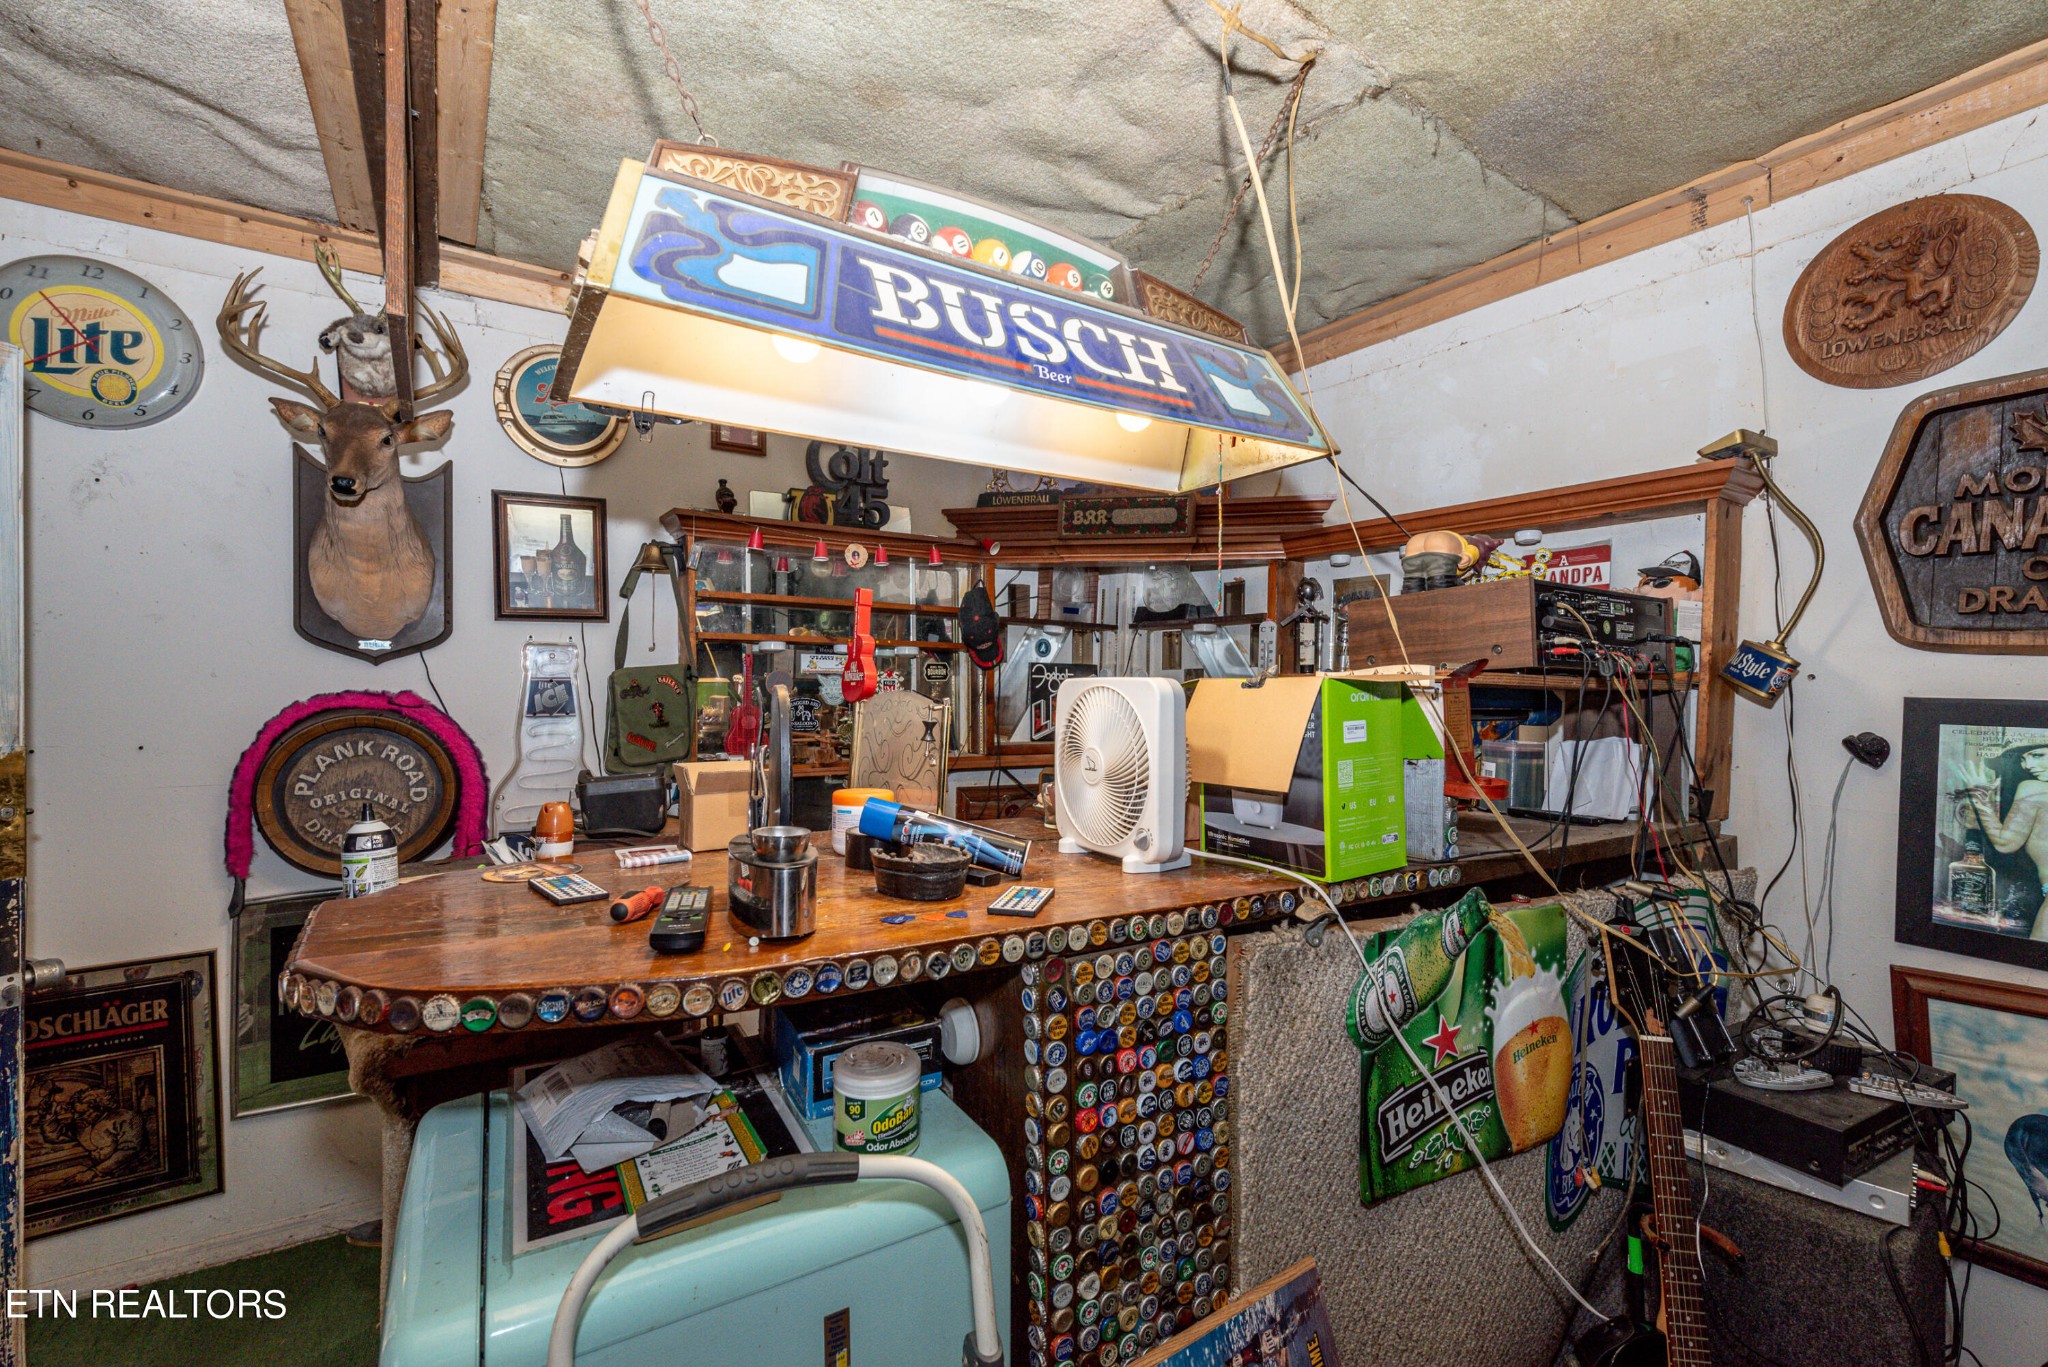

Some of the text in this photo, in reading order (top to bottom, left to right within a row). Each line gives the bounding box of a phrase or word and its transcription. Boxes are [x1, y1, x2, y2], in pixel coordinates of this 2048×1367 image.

[27, 264, 48, 279] 11
[80, 264, 105, 280] 12
[0, 287, 13, 299] 0
[138, 286, 148, 299] 1
[50, 306, 120, 326] Miller
[169, 318, 182, 331] 2
[858, 258, 1187, 393] BUSCH
[31, 317, 143, 375] Lite
[179, 352, 192, 365] 3
[1033, 364, 1072, 385] Beer
[26, 388, 41, 401] 7
[168, 384, 179, 396] 4
[82, 408, 95, 421] 6
[134, 405, 148, 417] 5
[806, 440, 890, 490] Colt
[1953, 465, 2048, 500] MO
[836, 484, 891, 531] 45
[1072, 509, 1108, 525] BAR
[1900, 494, 2048, 558] CANA
[1559, 554, 1570, 567] A
[1546, 565, 1603, 585] ANDPA
[1957, 585, 2048, 614] DRA
[1737, 652, 1771, 679] Style
[294, 740, 375, 796] PLANK
[380, 744, 428, 802] ROAD
[309, 788, 413, 814] ORIGINAL
[723, 984, 744, 1007] Lite
[25, 998, 169, 1042] DSCHLÄGER
[425, 1012, 457, 1021] GUINNESS
[1512, 1034, 1558, 1065] Heineken
[849, 1105, 861, 1115] 90
[1384, 1064, 1493, 1147] Heineken
[872, 1104, 914, 1135] OdoBan
[866, 1130, 918, 1152] Odor Absorber
[708, 1155, 796, 1195] COSCO
